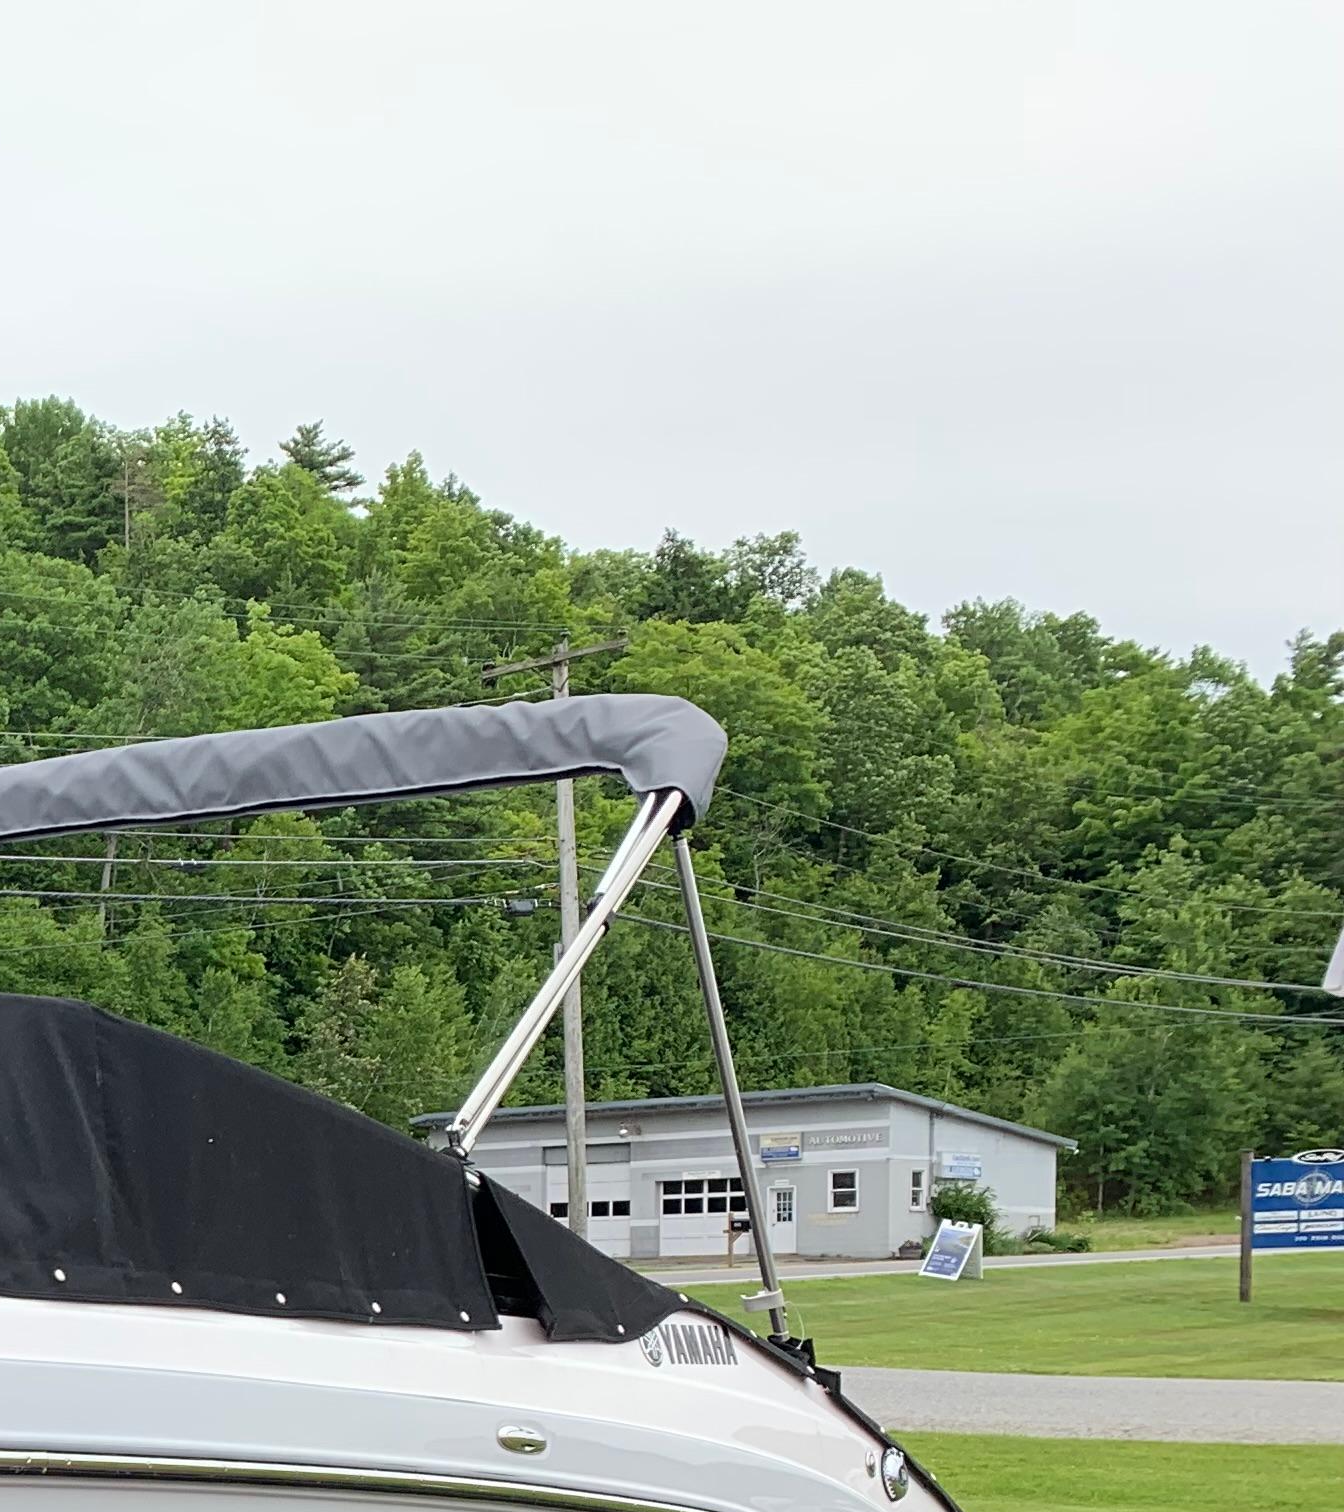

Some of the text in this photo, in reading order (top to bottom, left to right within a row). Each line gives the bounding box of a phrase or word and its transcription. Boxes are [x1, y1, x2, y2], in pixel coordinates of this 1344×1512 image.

[808, 1132, 883, 1145] AUTOMOTIVE
[1255, 1180, 1344, 1198] SABA MA
[658, 1324, 738, 1365] YAMAHA
